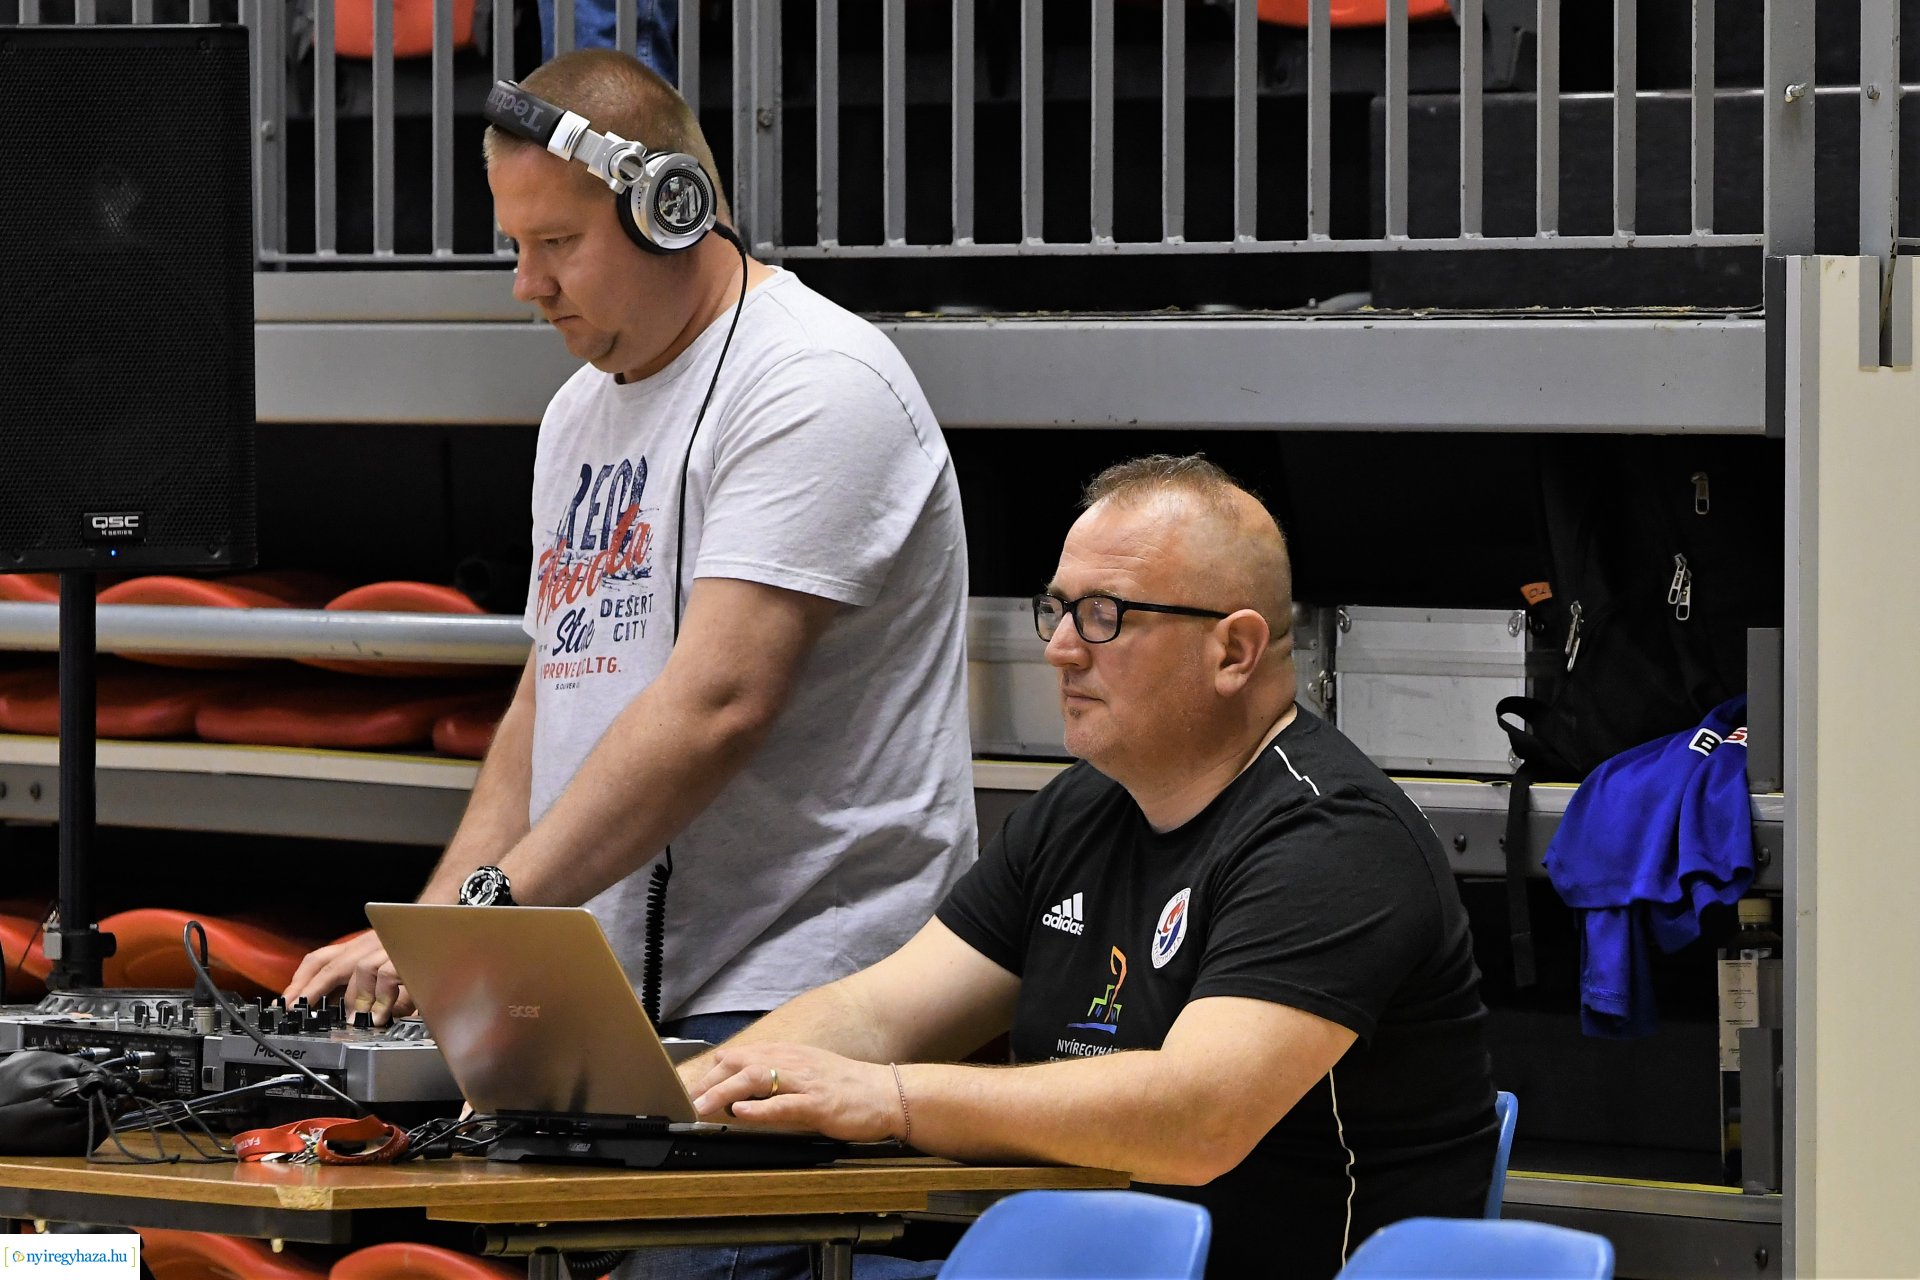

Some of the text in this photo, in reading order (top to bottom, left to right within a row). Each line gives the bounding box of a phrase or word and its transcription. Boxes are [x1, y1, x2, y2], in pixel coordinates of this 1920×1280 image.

[92, 516, 139, 529] QSC
[600, 593, 654, 618] DESERT
[613, 619, 647, 642] CITY
[1042, 913, 1084, 936] adidas
[508, 1005, 540, 1018] acer
[254, 1043, 306, 1060] Pioeer
[1056, 1038, 1120, 1057] NYÍREGYHÁ
